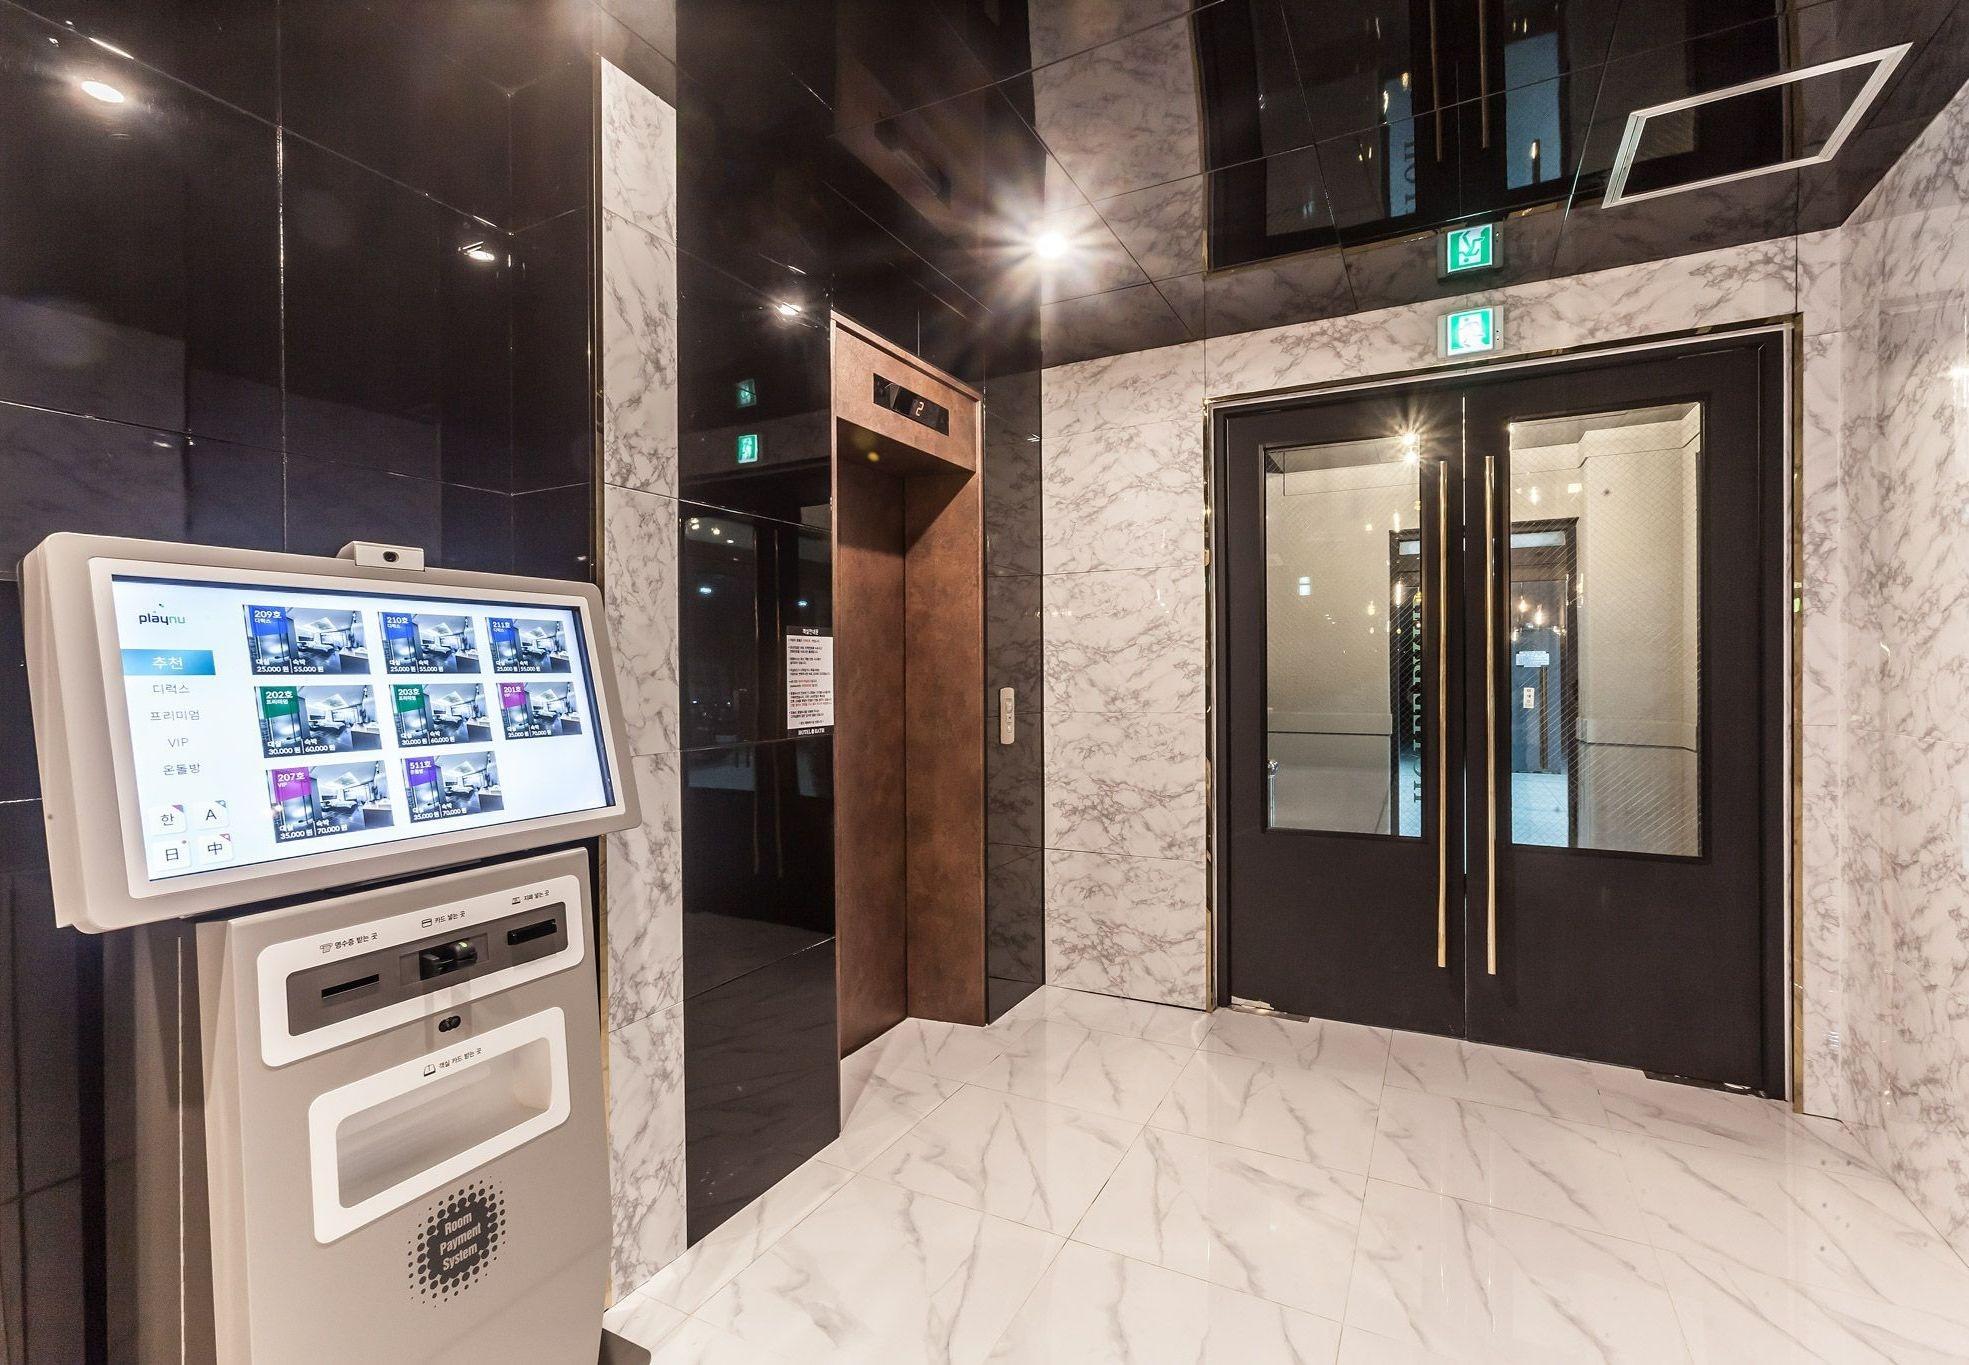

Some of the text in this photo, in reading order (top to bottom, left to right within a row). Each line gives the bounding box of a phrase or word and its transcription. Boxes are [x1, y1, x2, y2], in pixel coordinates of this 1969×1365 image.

[915, 401, 925, 417] 2
[139, 611, 186, 626] playnu
[254, 610, 282, 619] 209호
[152, 656, 184, 670] 추천
[153, 683, 191, 695] 디럭스
[265, 691, 293, 699] 202호
[149, 710, 200, 721] 프리미엄
[167, 737, 189, 748] VIP
[163, 763, 201, 776] 온돌방
[277, 772, 305, 782] 207호
[161, 812, 174, 827] 한
[205, 809, 217, 821] A
[165, 848, 179, 861] 日
[207, 841, 223, 856] 中
[542, 888, 550, 897] 곳
[434, 910, 467, 924] 카드 넣는 곳
[334, 932, 379, 951] 영수증 받는 곳
[450, 1055, 463, 1066] 카드
[462, 1050, 475, 1061] 받는
[475, 1047, 483, 1055] 곳
[444, 1212, 473, 1236] Room
[439, 1223, 481, 1256] Payment
[442, 1243, 478, 1271] System
